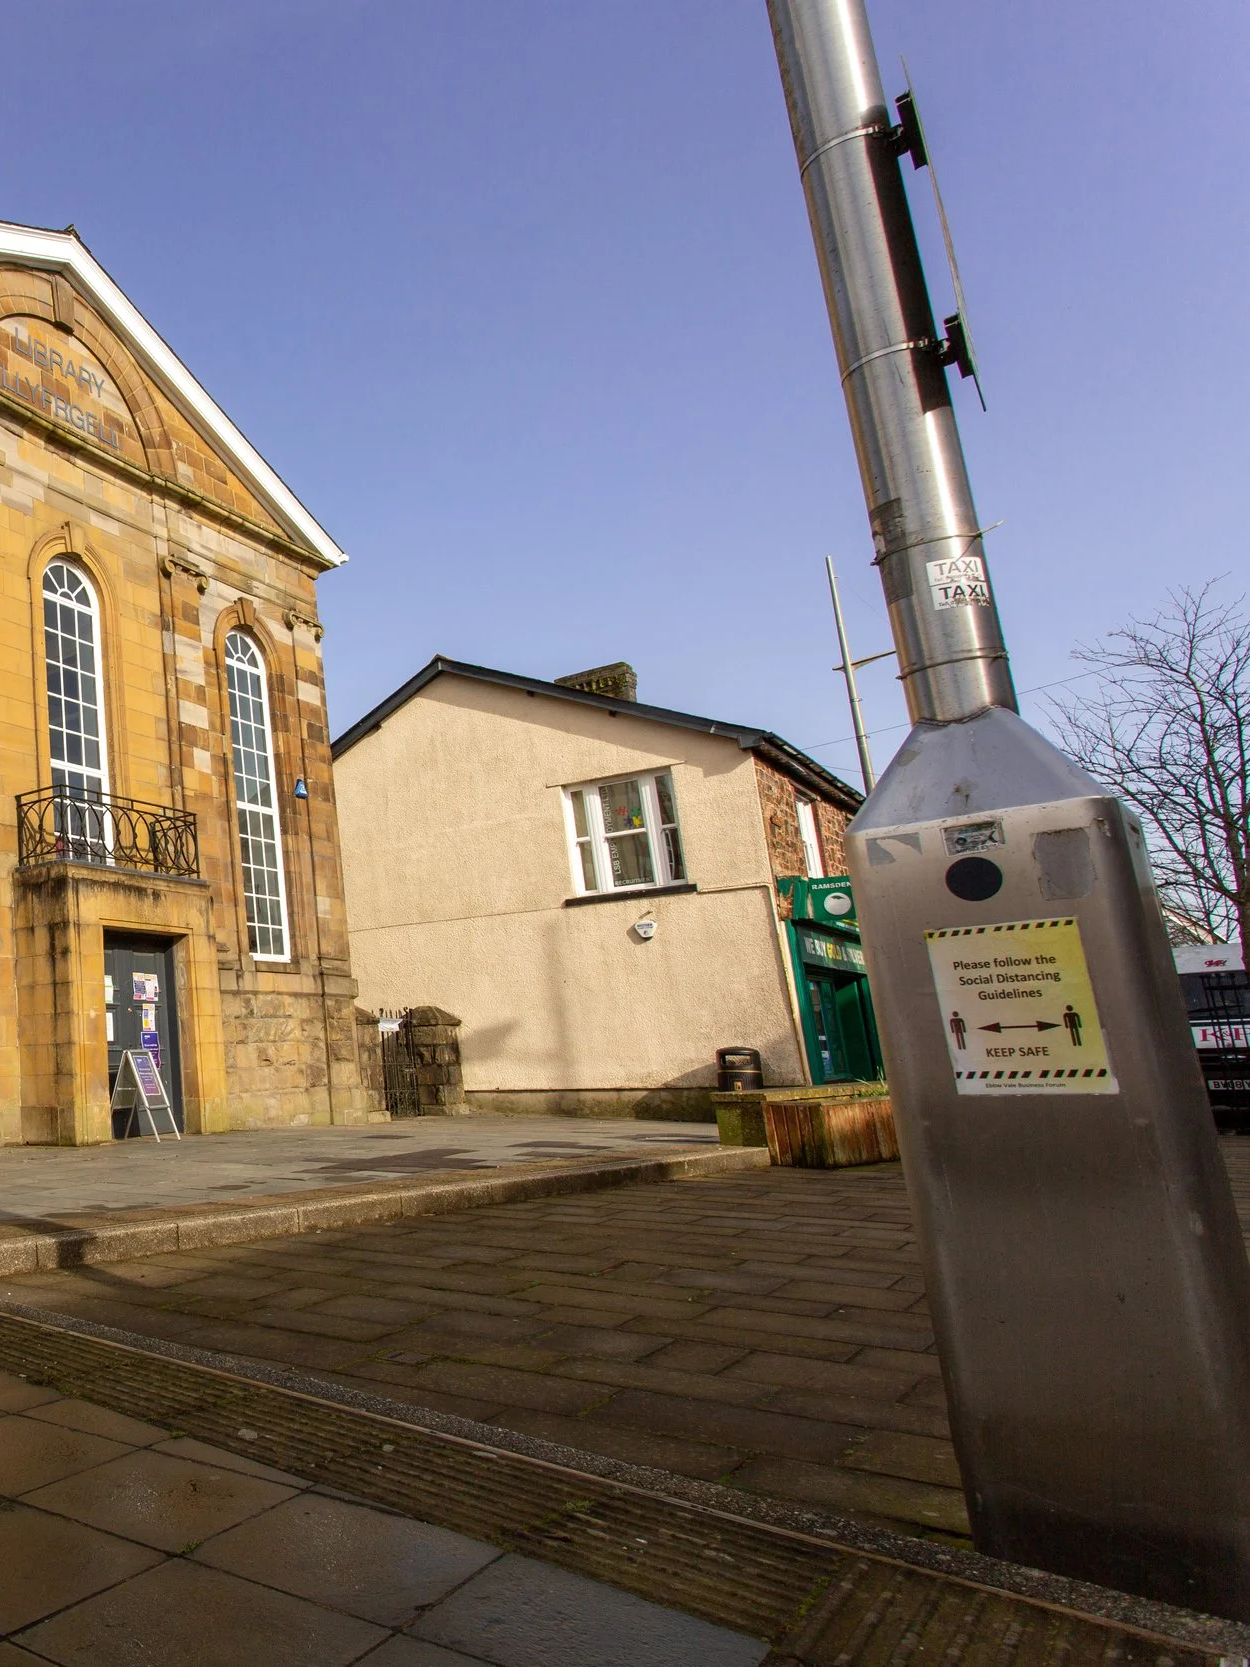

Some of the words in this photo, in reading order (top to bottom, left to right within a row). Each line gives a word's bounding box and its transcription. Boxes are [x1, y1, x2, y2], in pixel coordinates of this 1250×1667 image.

[14, 326, 105, 398] LIBRARY
[2, 361, 121, 451] LLYFRGELL
[934, 560, 979, 576] TAXI
[938, 584, 986, 600] TAXI
[953, 960, 991, 970] Please
[993, 957, 1032, 968] follow
[1035, 954, 1057, 965] the
[958, 974, 994, 986] Social
[996, 971, 1062, 984] Distancing
[978, 988, 1043, 1001] Guidelines
[986, 1047, 1016, 1057] KEEP
[1018, 1046, 1050, 1057] SAFE
